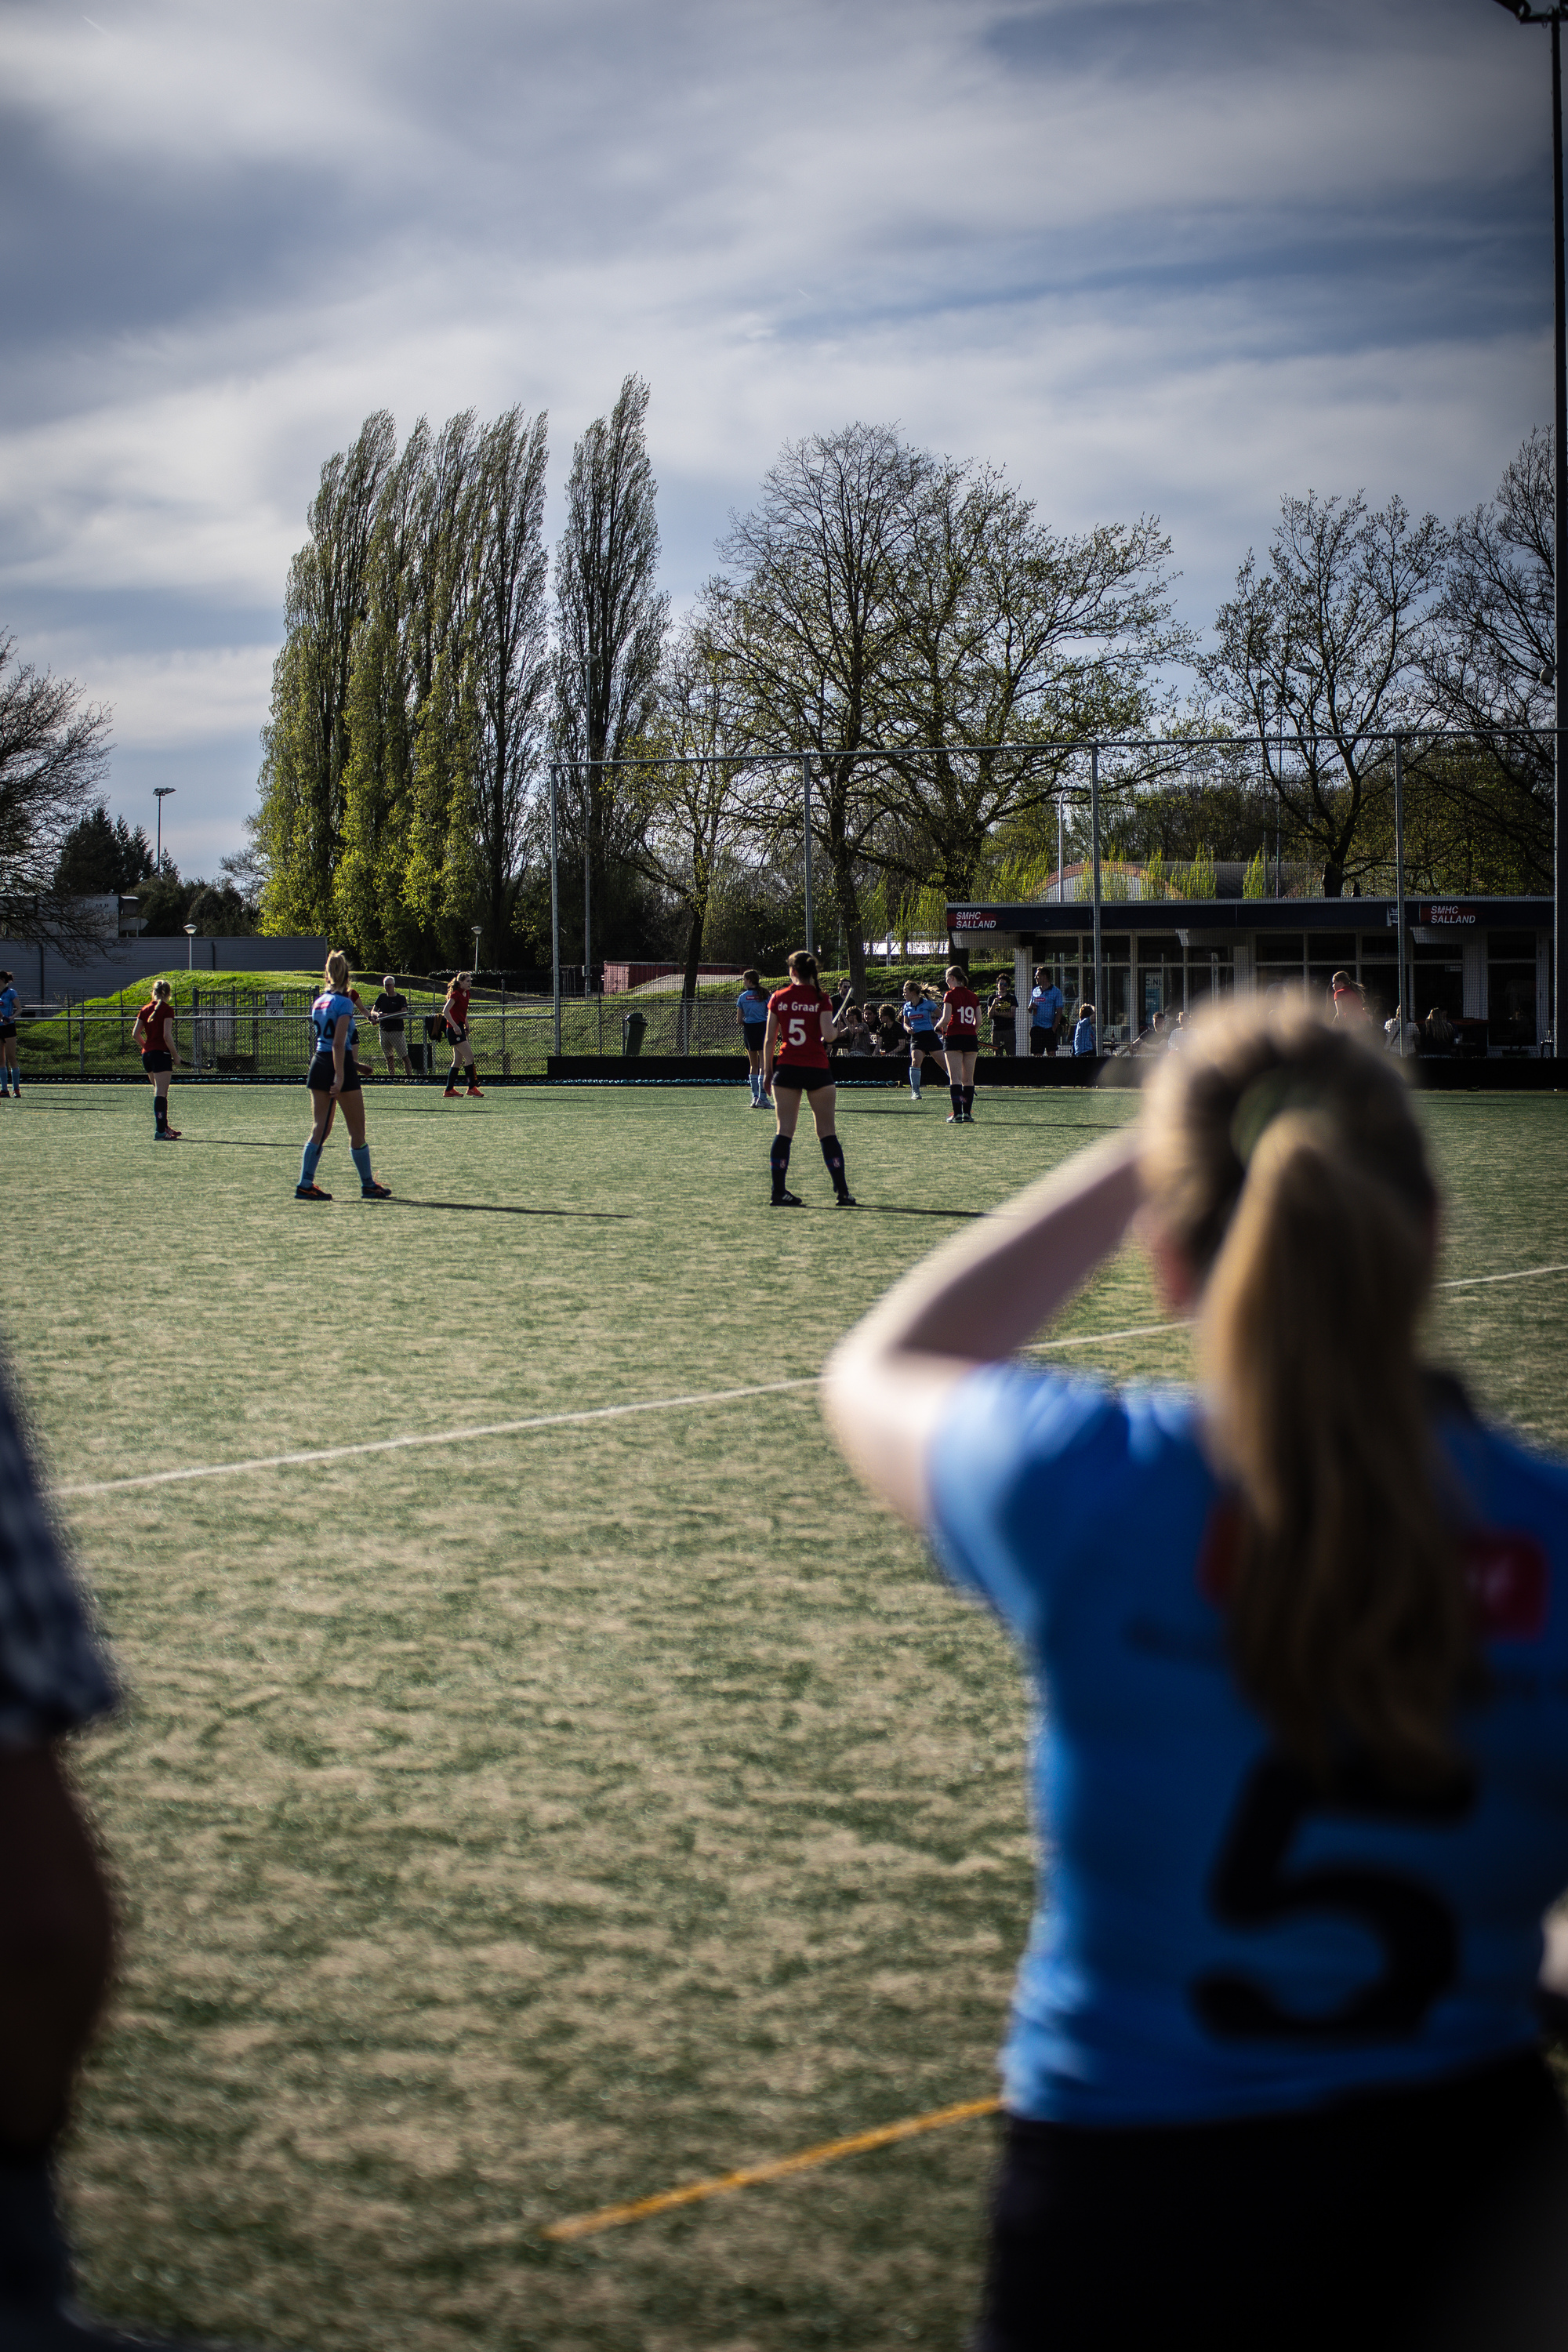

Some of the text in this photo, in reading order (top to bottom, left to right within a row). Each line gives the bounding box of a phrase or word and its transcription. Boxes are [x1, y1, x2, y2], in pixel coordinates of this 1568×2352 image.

[956, 911, 981, 920] SMHC
[1431, 915, 1475, 924] SALLAND
[778, 1001, 820, 1012] de Graaf
[957, 1006, 975, 1024] 19
[788, 1018, 807, 1046] 5
[1198, 1756, 1472, 2041] 5
